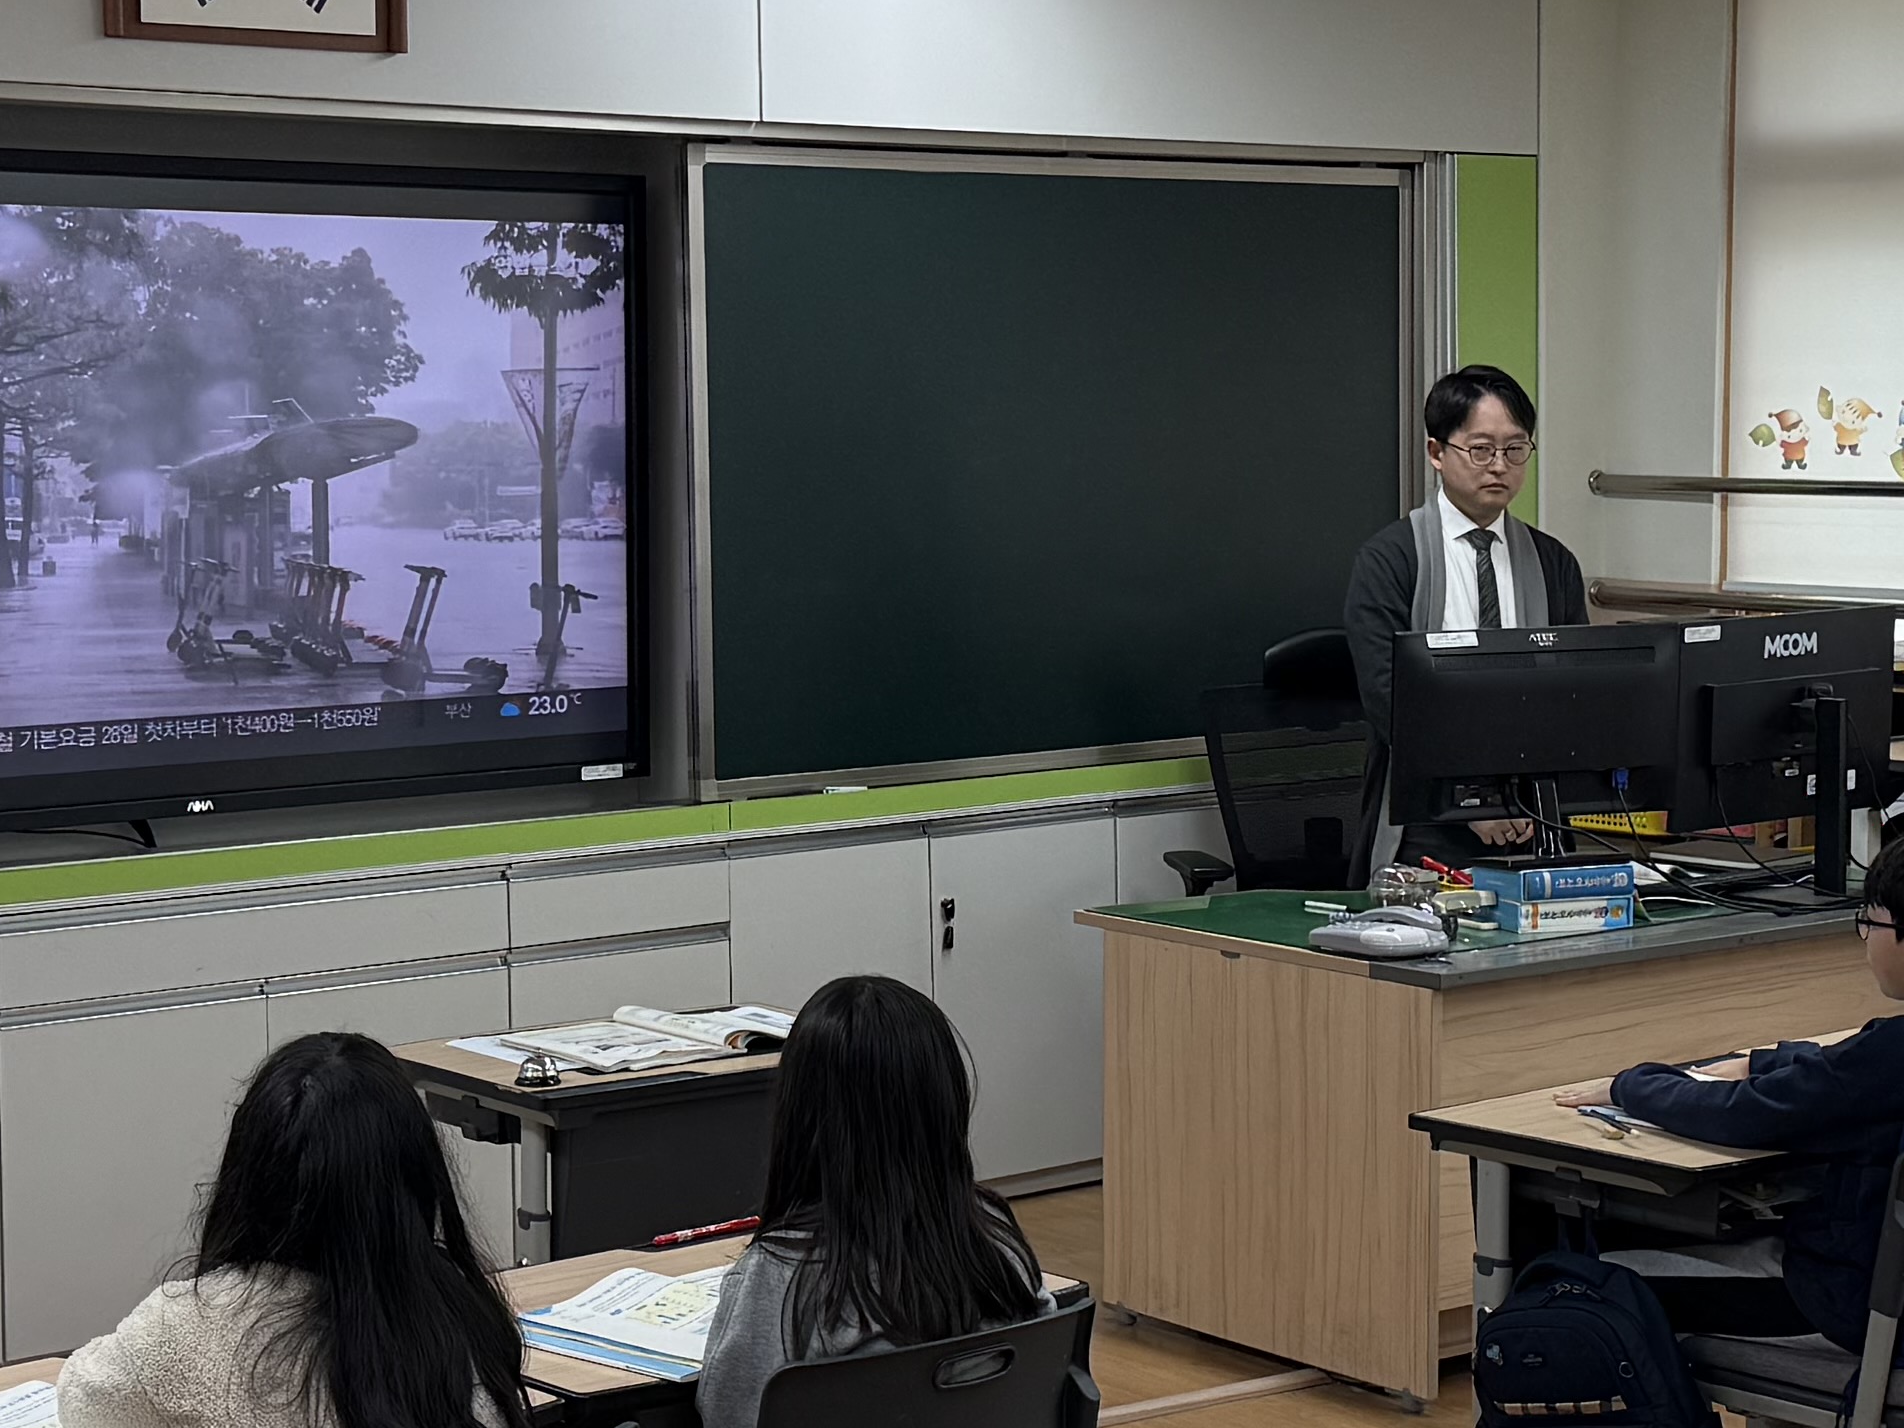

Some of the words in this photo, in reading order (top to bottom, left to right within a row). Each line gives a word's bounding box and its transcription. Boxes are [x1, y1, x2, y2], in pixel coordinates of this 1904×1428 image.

[1763, 631, 1818, 659] MCOM
[445, 702, 473, 719] 부산
[20, 726, 96, 750] 기본요금
[144, 718, 218, 743] 첫차부터
